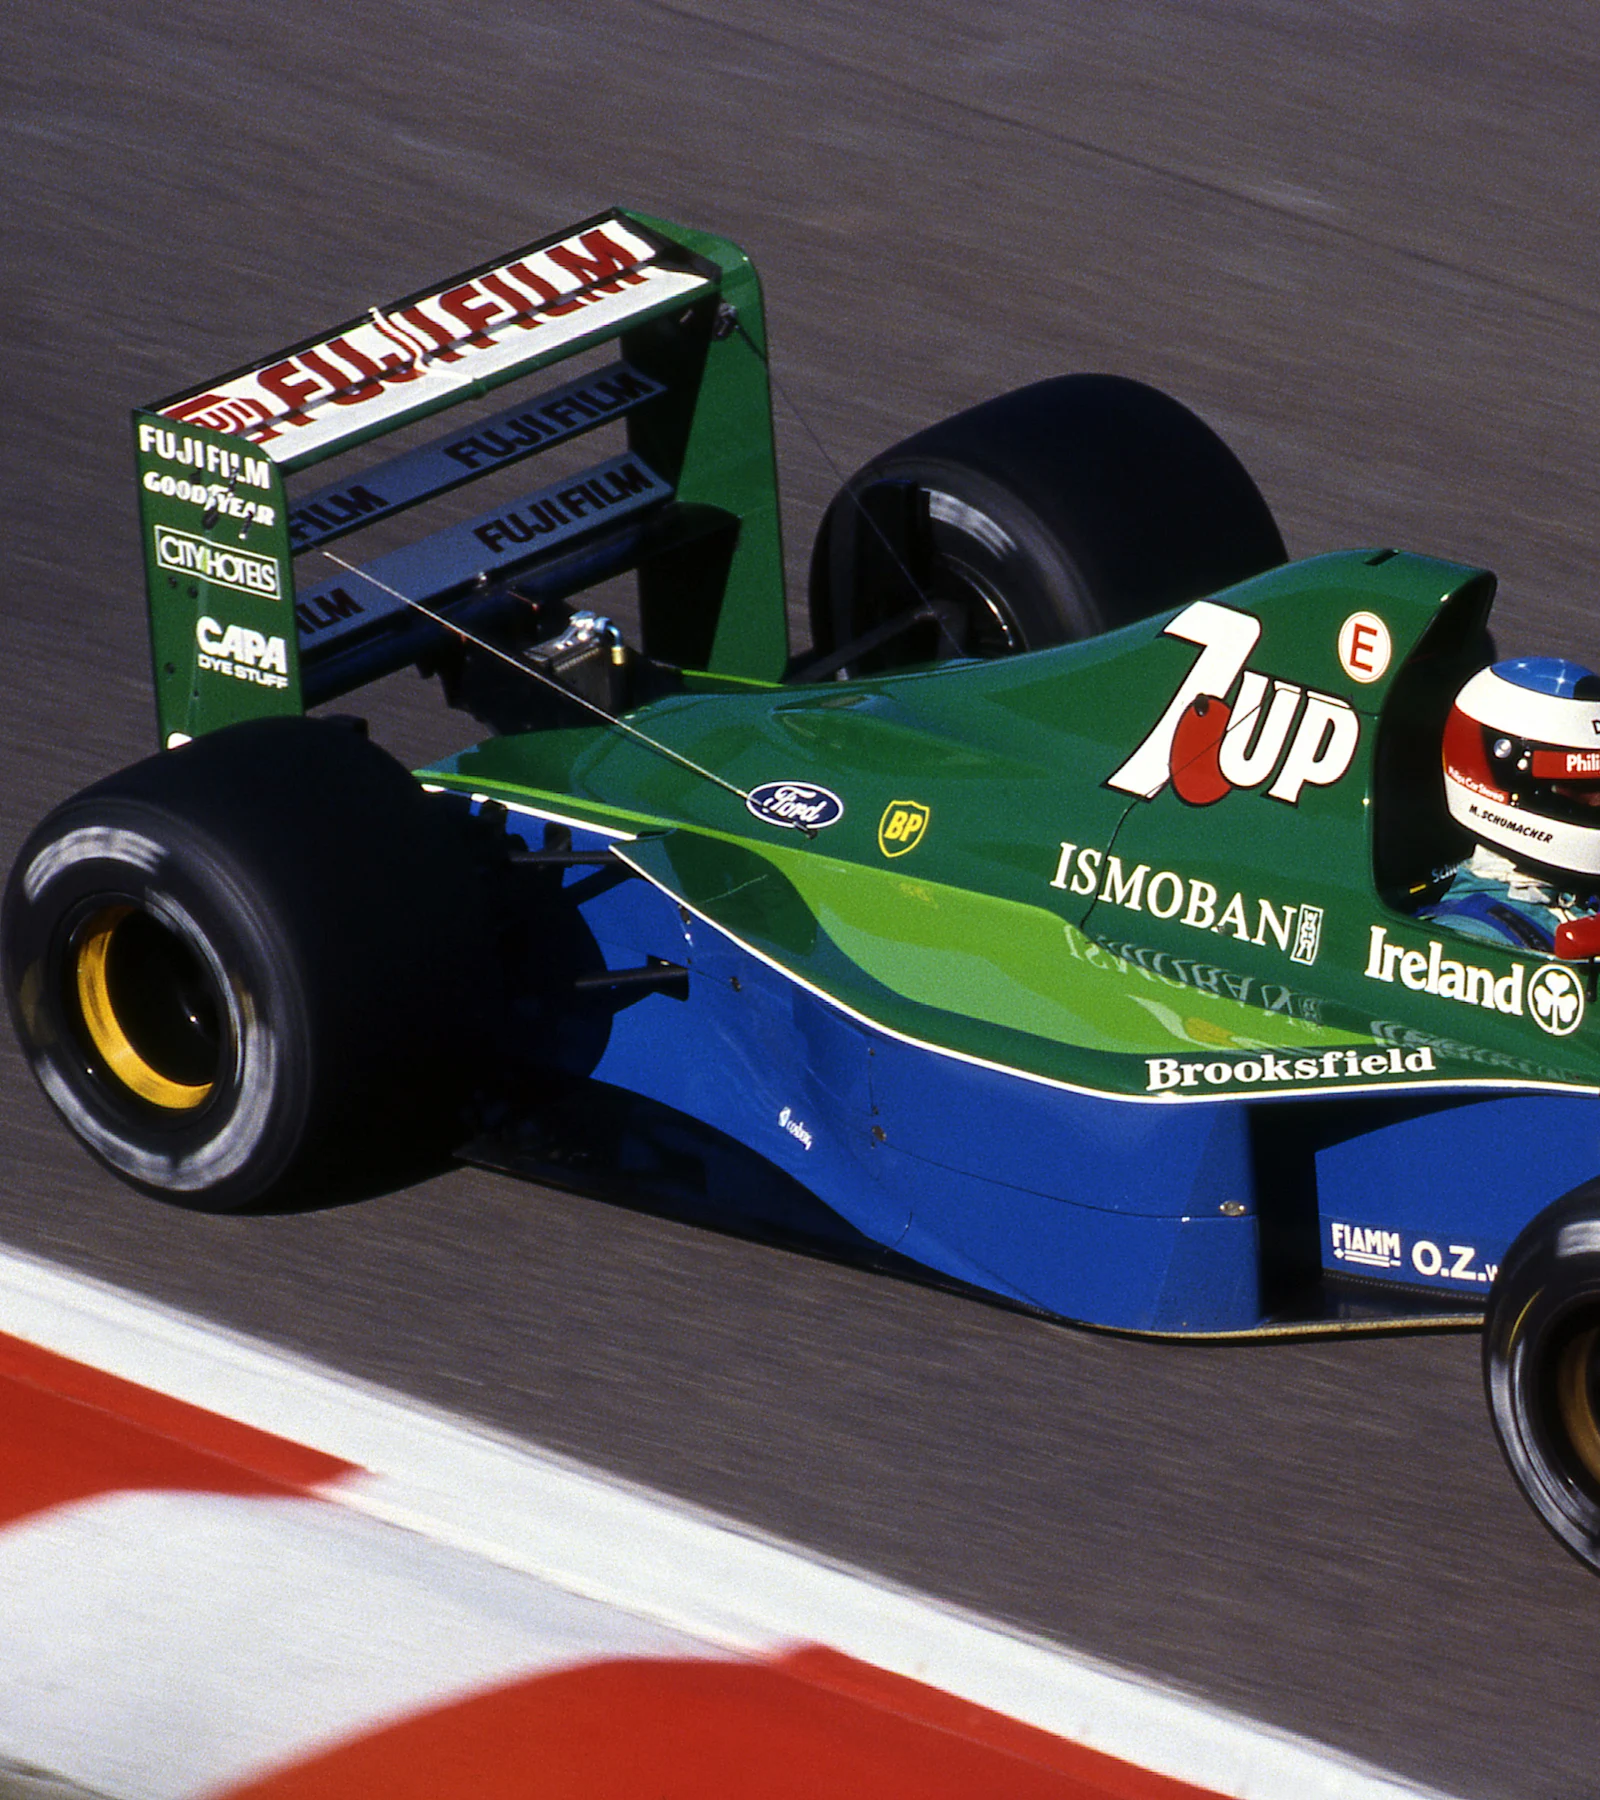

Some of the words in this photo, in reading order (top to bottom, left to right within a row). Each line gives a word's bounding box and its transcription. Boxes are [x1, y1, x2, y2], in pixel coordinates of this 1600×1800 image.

[257, 229, 650, 427] FUJIFILM
[444, 371, 657, 469] FUJIFILM
[138, 424, 271, 489] FUJIFILM
[143, 471, 276, 526] GOODYEAR
[473, 463, 653, 552] FUJIFILM
[196, 616, 287, 675] CAPA
[1349, 622, 1378, 673] E
[1105, 600, 1361, 803] 7UP
[763, 785, 828, 823] Ford
[884, 810, 924, 842] BP
[1049, 841, 1298, 952] ISMOBAN
[1364, 925, 1524, 1016] Ireland
[1145, 1046, 1436, 1091] Brooksfield
[1331, 1223, 1401, 1258] FIAMM
